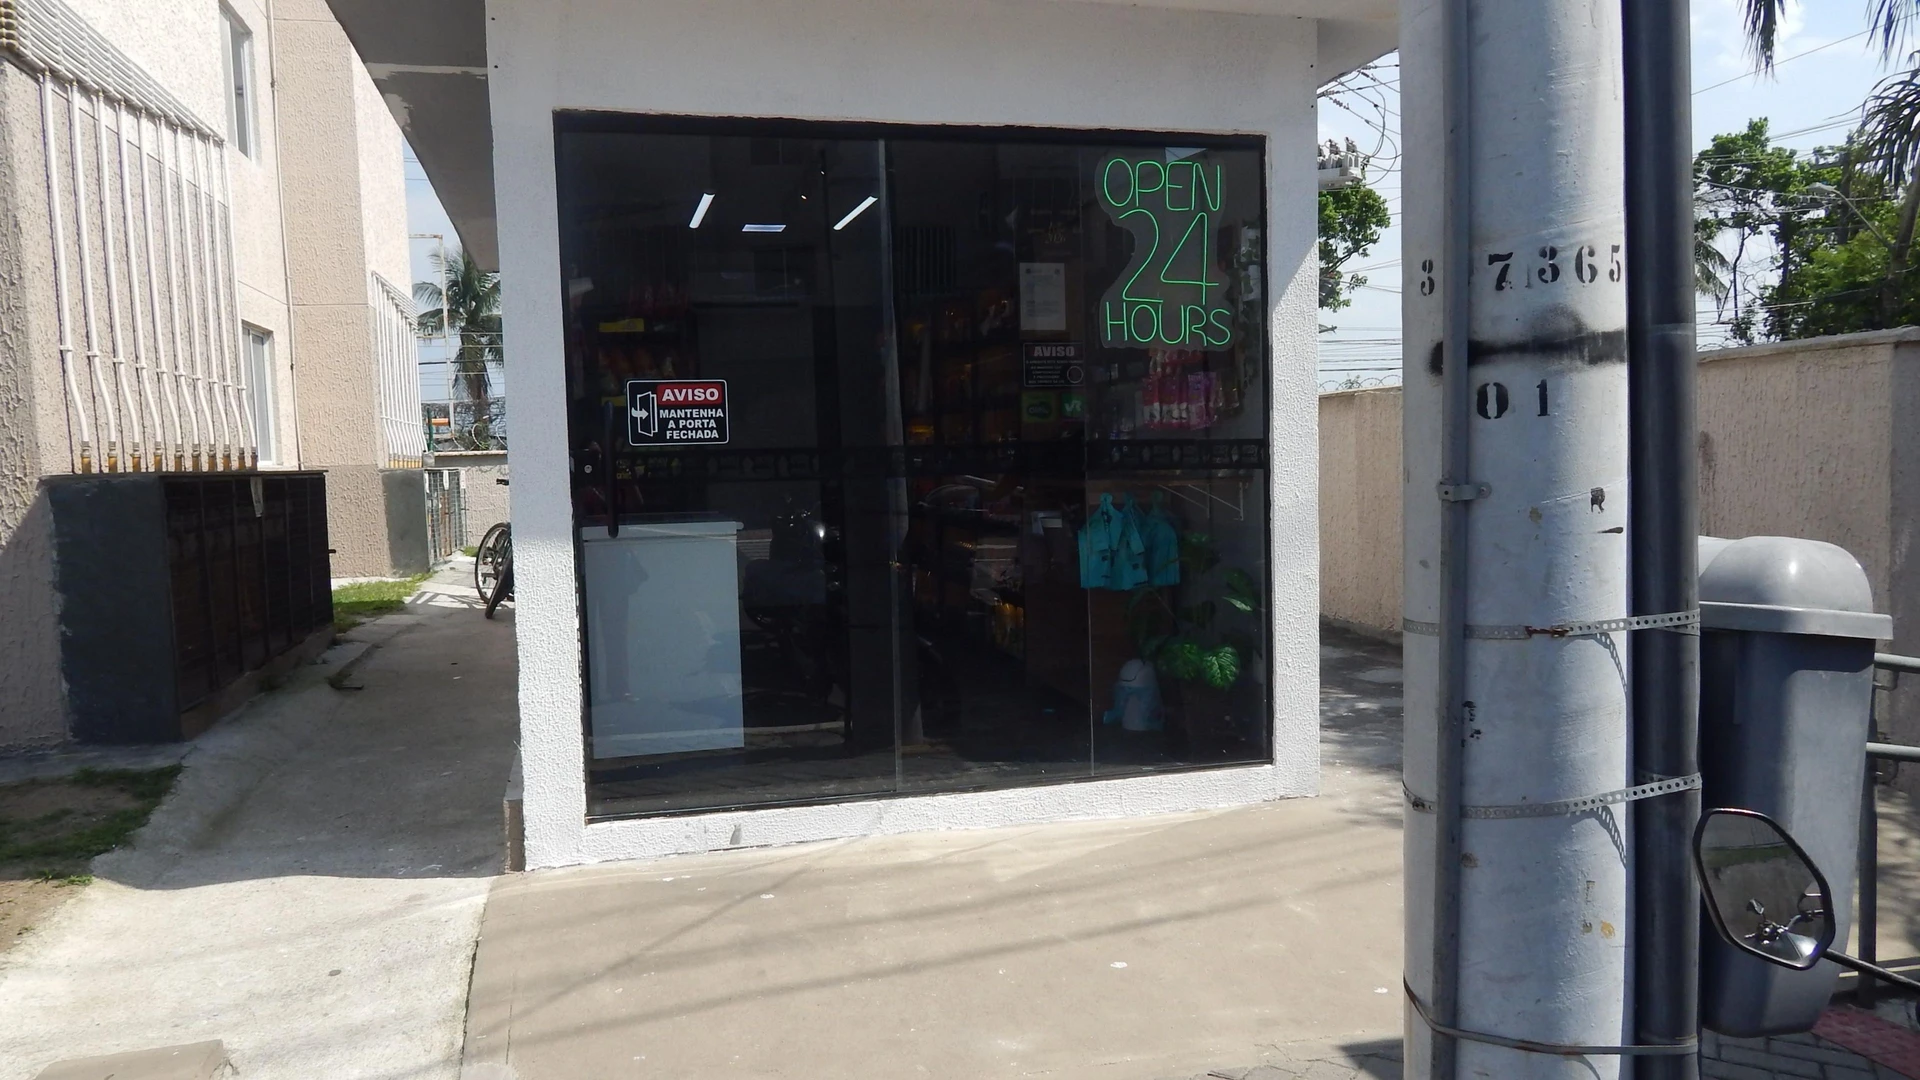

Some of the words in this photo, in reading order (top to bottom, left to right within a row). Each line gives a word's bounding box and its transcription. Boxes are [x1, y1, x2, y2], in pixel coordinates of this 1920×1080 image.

[1103, 157, 1221, 212] OPEN
[1118, 207, 1220, 306] 24
[1105, 301, 1231, 347] HOURS
[1033, 346, 1075, 357] AVISO
[661, 388, 719, 402] AVISO
[659, 408, 724, 419] MANTENHA
[667, 419, 676, 429] A
[679, 419, 717, 429] PORTA
[666, 429, 719, 440] FECHADA
